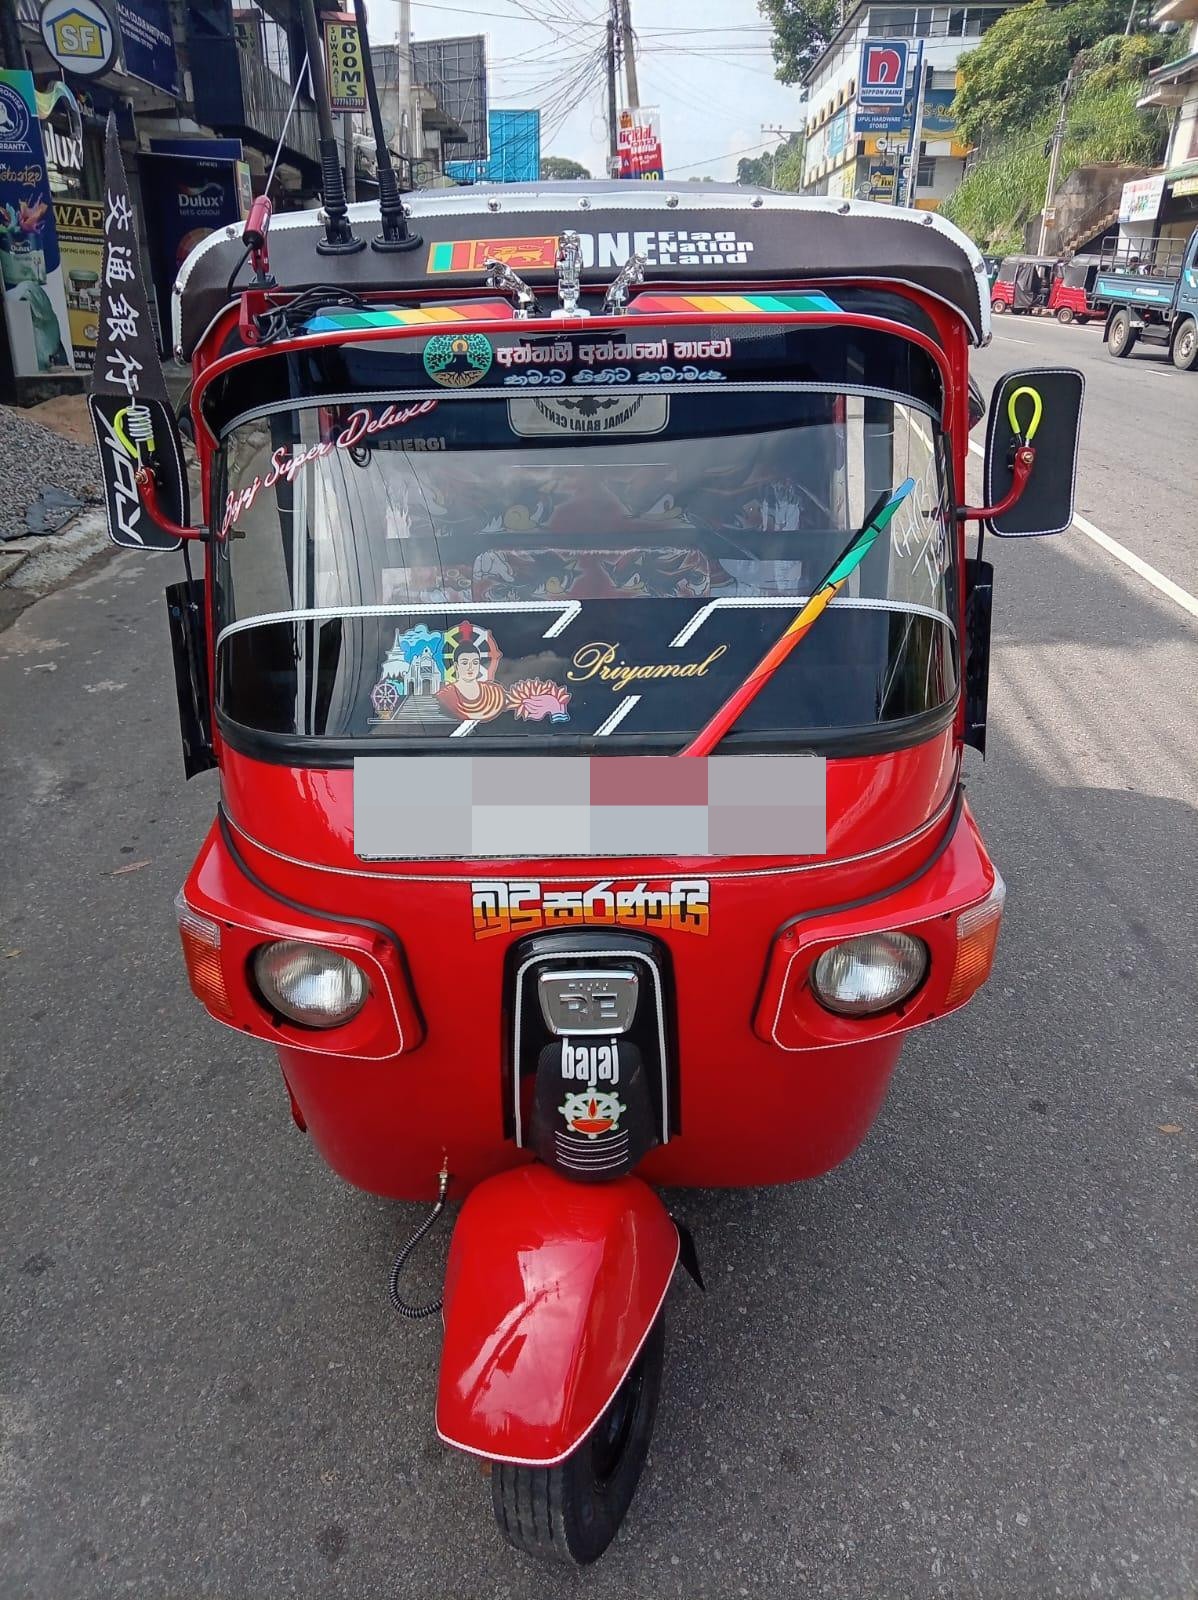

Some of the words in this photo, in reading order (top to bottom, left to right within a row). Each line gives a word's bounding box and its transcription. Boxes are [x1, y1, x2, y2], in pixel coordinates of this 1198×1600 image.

[61, 25, 95, 51] SF
[329, 26, 339, 75] SUWANA
[341, 27, 361, 97] ROOMS
[178, 194, 220, 207] Dulux
[53, 205, 104, 228] WAP
[658, 231, 736, 241] Flag
[658, 241, 754, 253] Nation
[659, 252, 747, 265] Land
[264, 441, 336, 484] Super
[336, 399, 440, 448] Deluxe
[566, 641, 731, 692] Priyamal
[561, 1037, 621, 1087] bajaj
